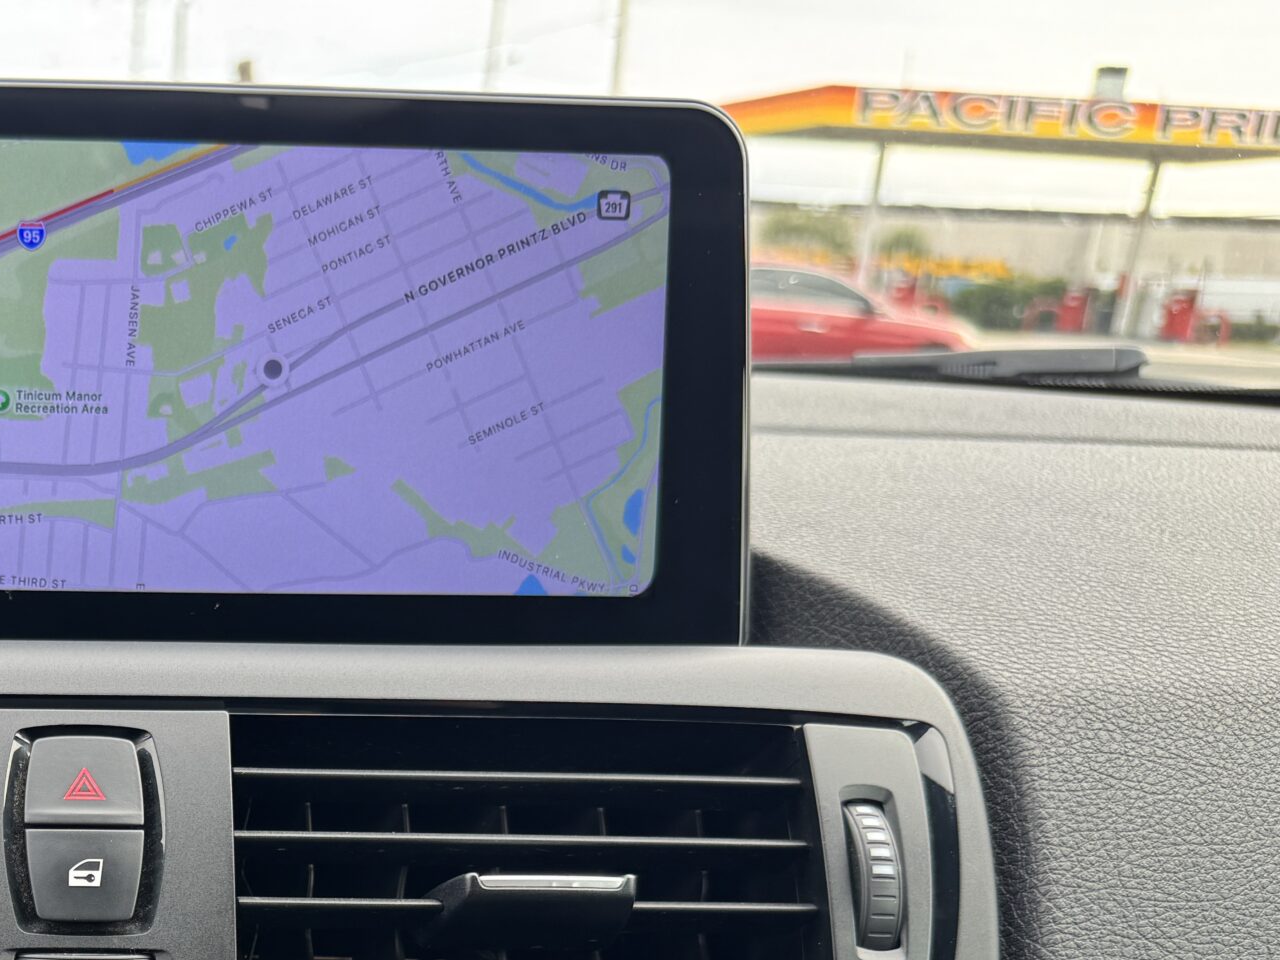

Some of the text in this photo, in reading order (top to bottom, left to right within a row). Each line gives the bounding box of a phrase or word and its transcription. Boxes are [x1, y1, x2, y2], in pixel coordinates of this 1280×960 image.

[858, 87, 1137, 138] PACIFIC
[610, 160, 627, 171] DR
[195, 187, 274, 233] CHIPPEWA ST
[292, 176, 374, 221] DELAWARE ST
[446, 181, 463, 204] AVE
[605, 202, 622, 214] 291
[23, 230, 40, 244] 95
[308, 205, 382, 248] MOHICAN ST
[322, 235, 391, 274] PONTIAC ST
[404, 211, 587, 304] N GOVERNOR PRINTZ BLVD
[125, 286, 141, 367] JANSEN AVE
[267, 296, 333, 334] SENECA ST
[426, 321, 526, 373] POWHATTAN AVE
[15, 403, 109, 415] Recreation Area
[16, 390, 102, 402] Tinicum Manor
[467, 402, 546, 445] SEMINOLE ST
[27, 514, 43, 525] ST
[0, 575, 67, 589] E THIRD ST
[498, 550, 568, 584] INDUSTRIAL
[571, 576, 606, 593] PKWY
